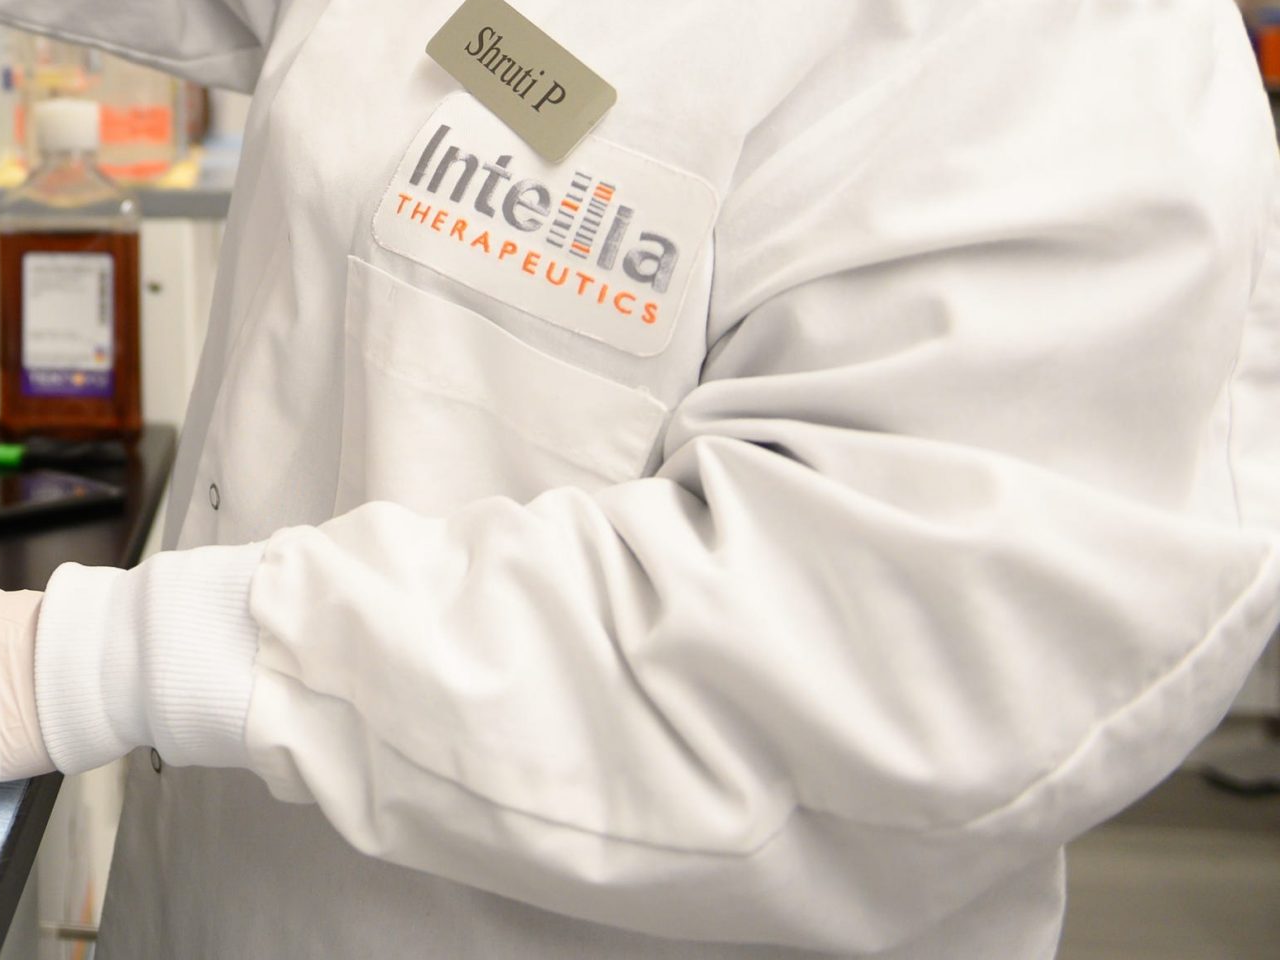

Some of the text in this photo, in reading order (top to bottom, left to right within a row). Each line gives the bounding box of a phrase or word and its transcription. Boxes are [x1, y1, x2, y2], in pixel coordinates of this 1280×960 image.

[464, 26, 567, 113] Shruti P
[395, 192, 660, 325] THERAPEUTICS
